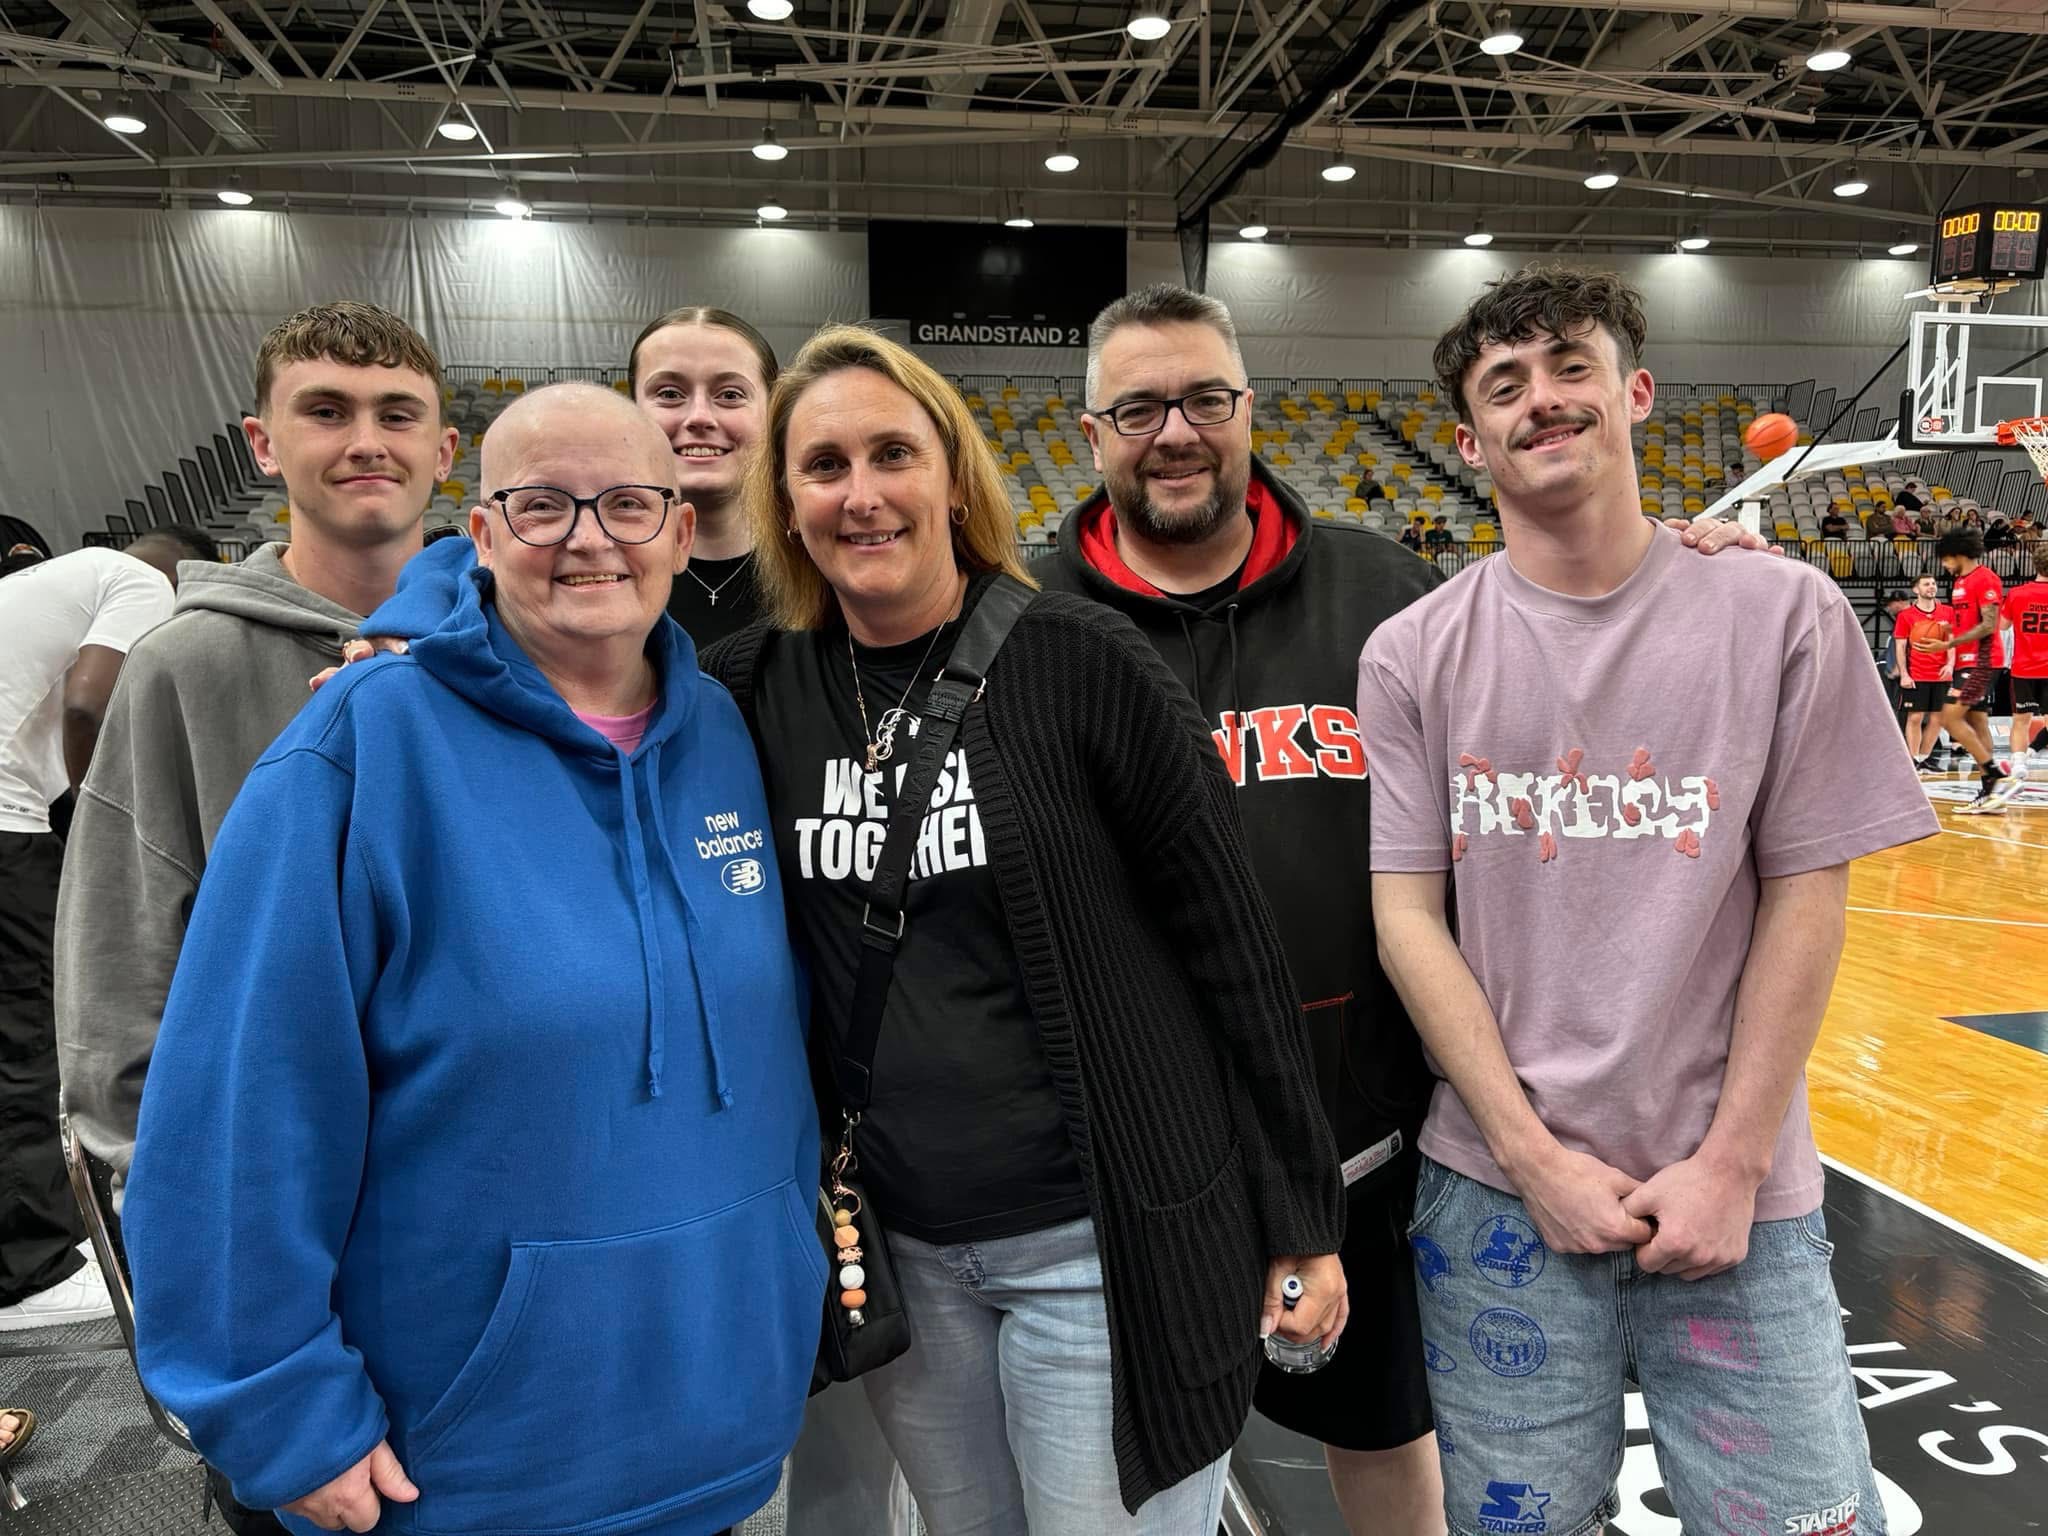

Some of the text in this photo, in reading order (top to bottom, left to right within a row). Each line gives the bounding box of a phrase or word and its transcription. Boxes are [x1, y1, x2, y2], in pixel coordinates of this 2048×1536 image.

[918, 324, 1081, 345] GRANDSTAND 2
[823, 757, 889, 818] WE
[704, 811, 740, 833] new
[695, 829, 764, 860] balance
[1478, 1517, 1547, 1534] STARTER
